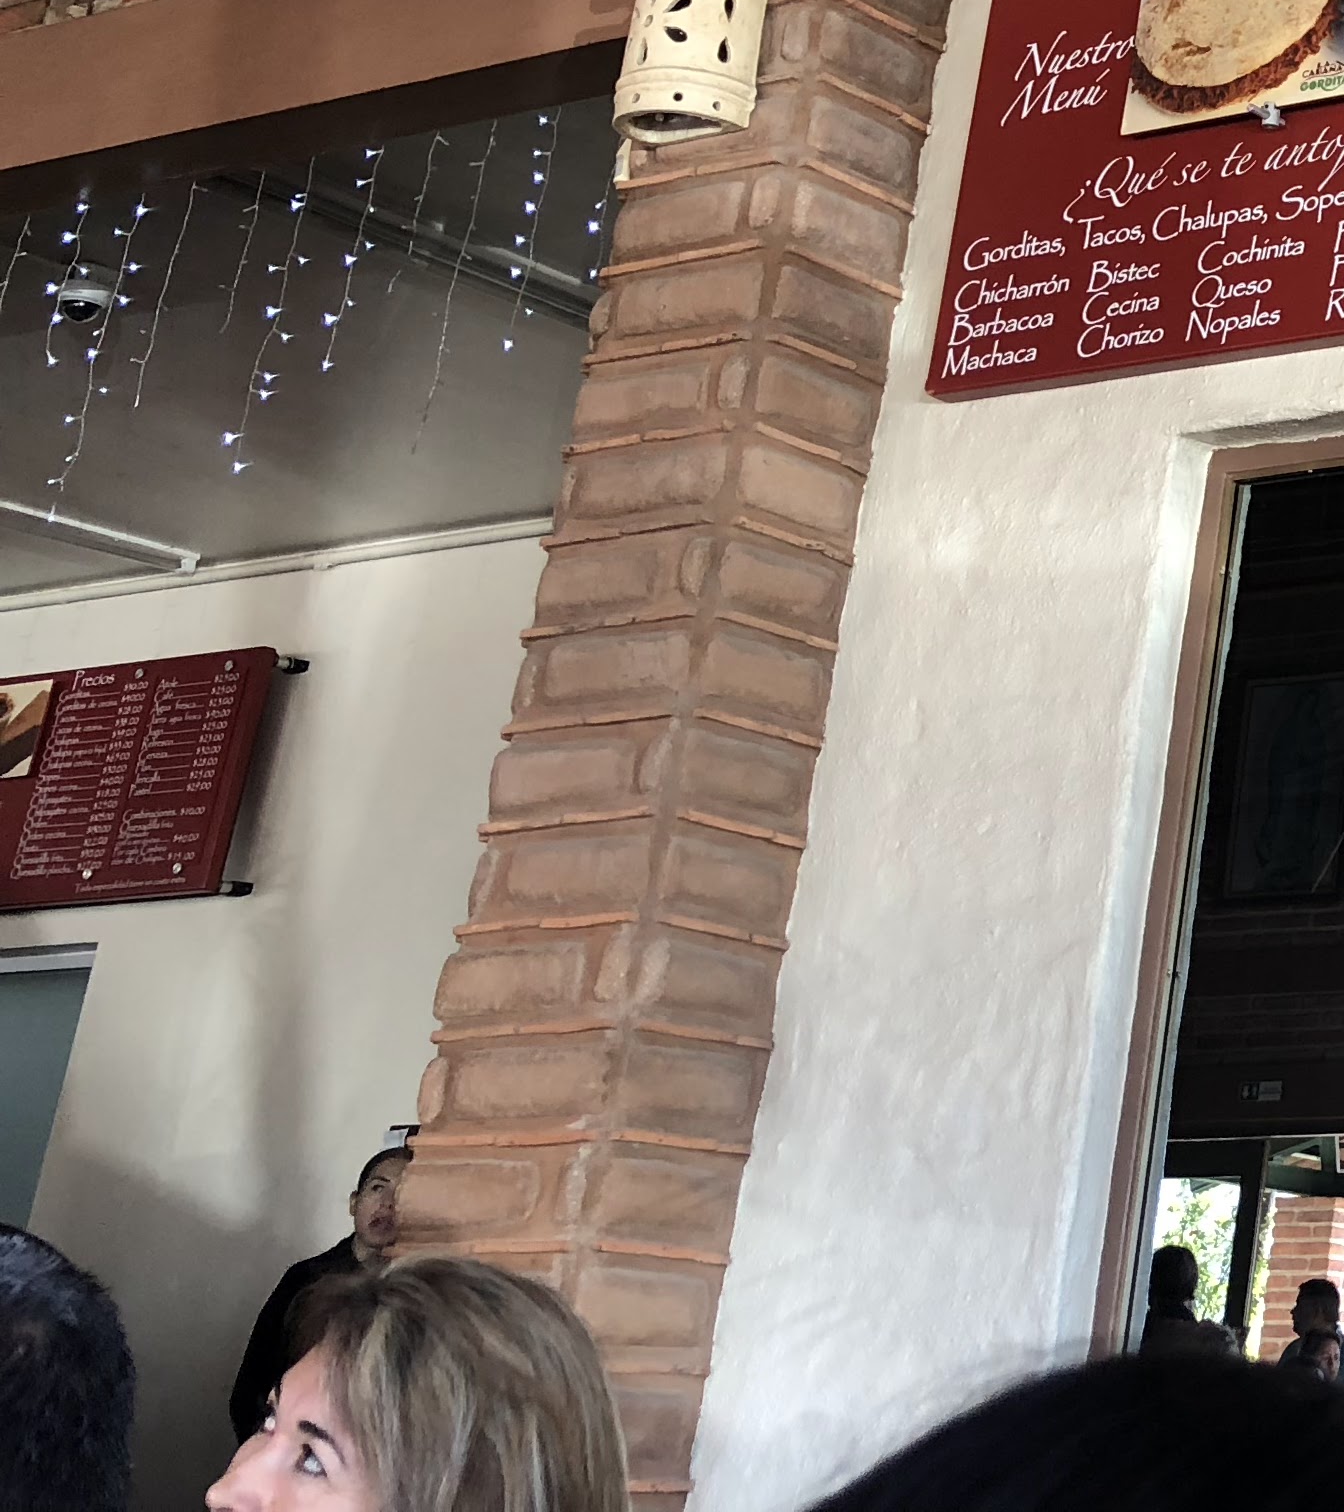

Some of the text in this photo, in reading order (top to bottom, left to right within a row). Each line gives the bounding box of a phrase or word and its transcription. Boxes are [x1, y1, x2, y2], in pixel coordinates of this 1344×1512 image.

[1015, 31, 1135, 82] Nuestro
[1001, 68, 1110, 126] Menú
[1063, 152, 1176, 223] ¿Qué
[1173, 161, 1211, 186] se
[1221, 142, 1256, 177] te
[964, 230, 1065, 271] Gorditas,
[1078, 215, 1145, 249] Tacos,
[1152, 200, 1268, 241] Chalupas,
[1198, 235, 1305, 274] Cochinita
[954, 274, 1070, 312] Chicharrón
[1086, 260, 1160, 292] Bistec
[1192, 275, 1272, 308] Queso
[948, 308, 1054, 346] Barbacoa
[1082, 292, 1159, 324] Cecina
[1185, 299, 1281, 344] Nopales
[941, 340, 1037, 378] Machaca
[1077, 323, 1164, 358] Chorizo
